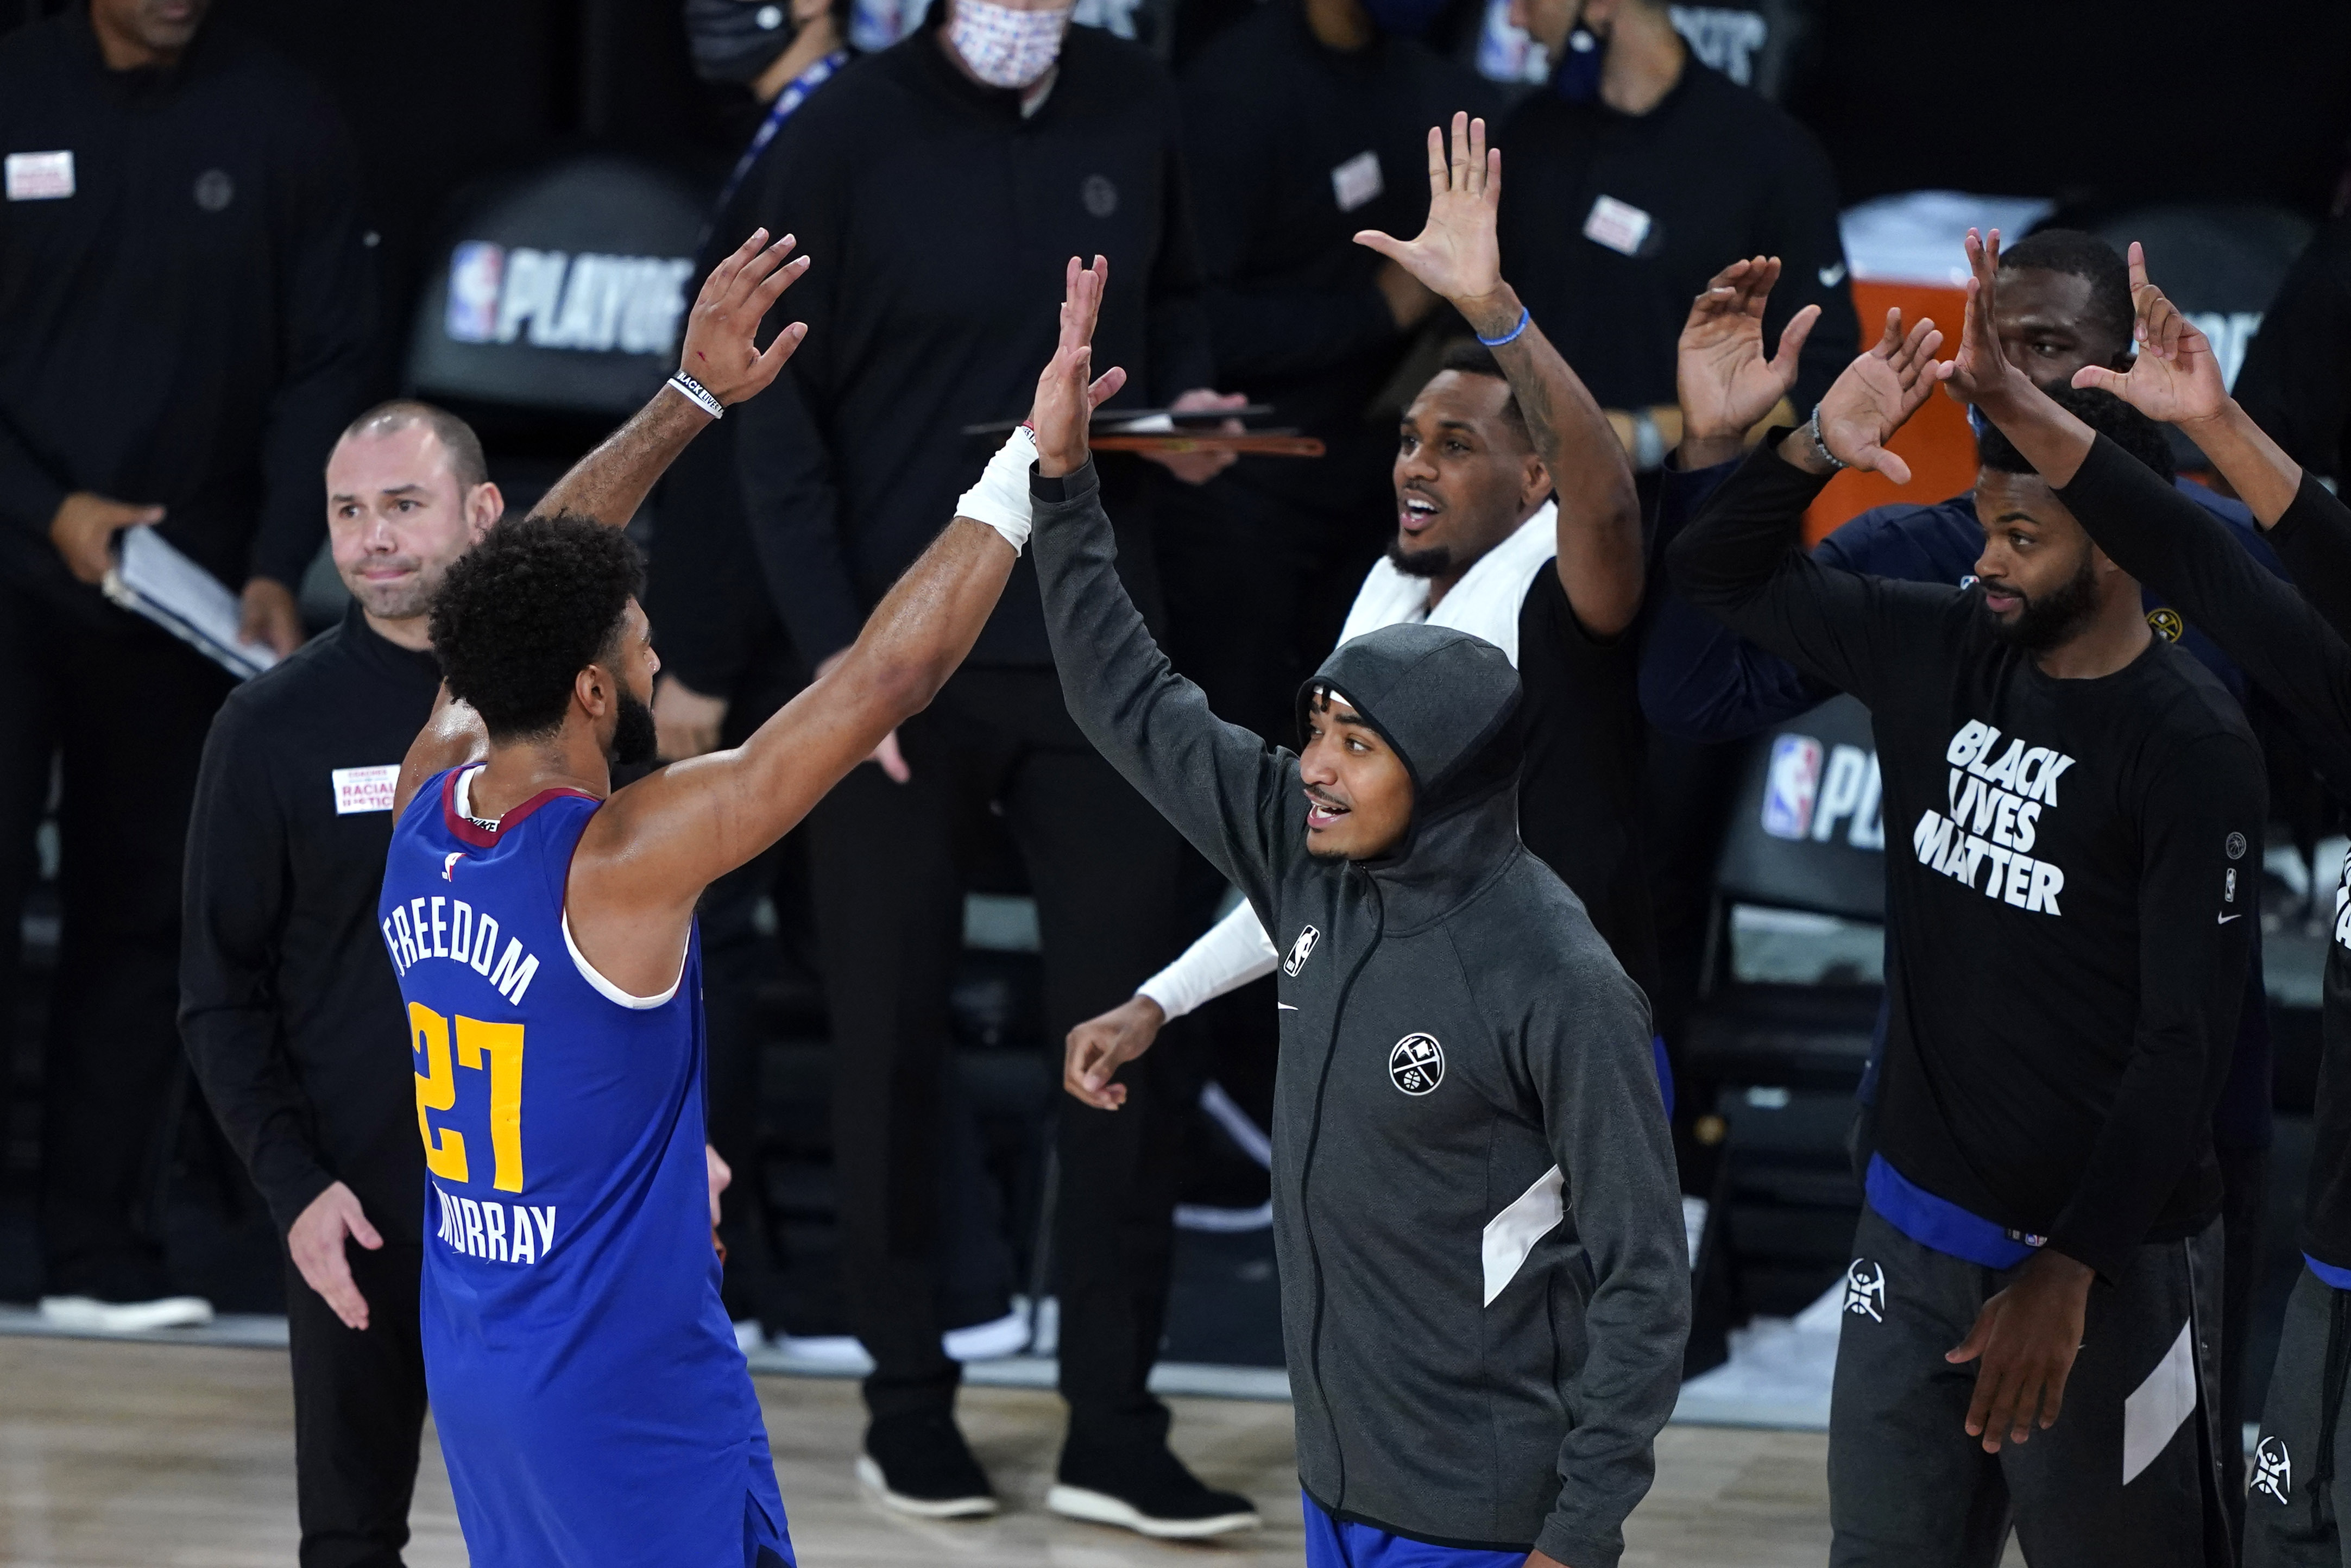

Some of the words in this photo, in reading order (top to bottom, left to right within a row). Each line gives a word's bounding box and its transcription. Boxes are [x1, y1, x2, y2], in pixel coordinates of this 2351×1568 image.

[677, 373, 703, 395] BLACK
[702, 393, 719, 410] LIVES
[343, 783, 394, 796] RACIAL
[1946, 719, 2076, 808] BLACK
[1949, 767, 2042, 853] LIVES
[1913, 809, 2064, 917] MATTER
[383, 896, 540, 1006] FREEDOM
[408, 1002, 525, 1194] 27
[432, 1181, 556, 1265] MURRAY
